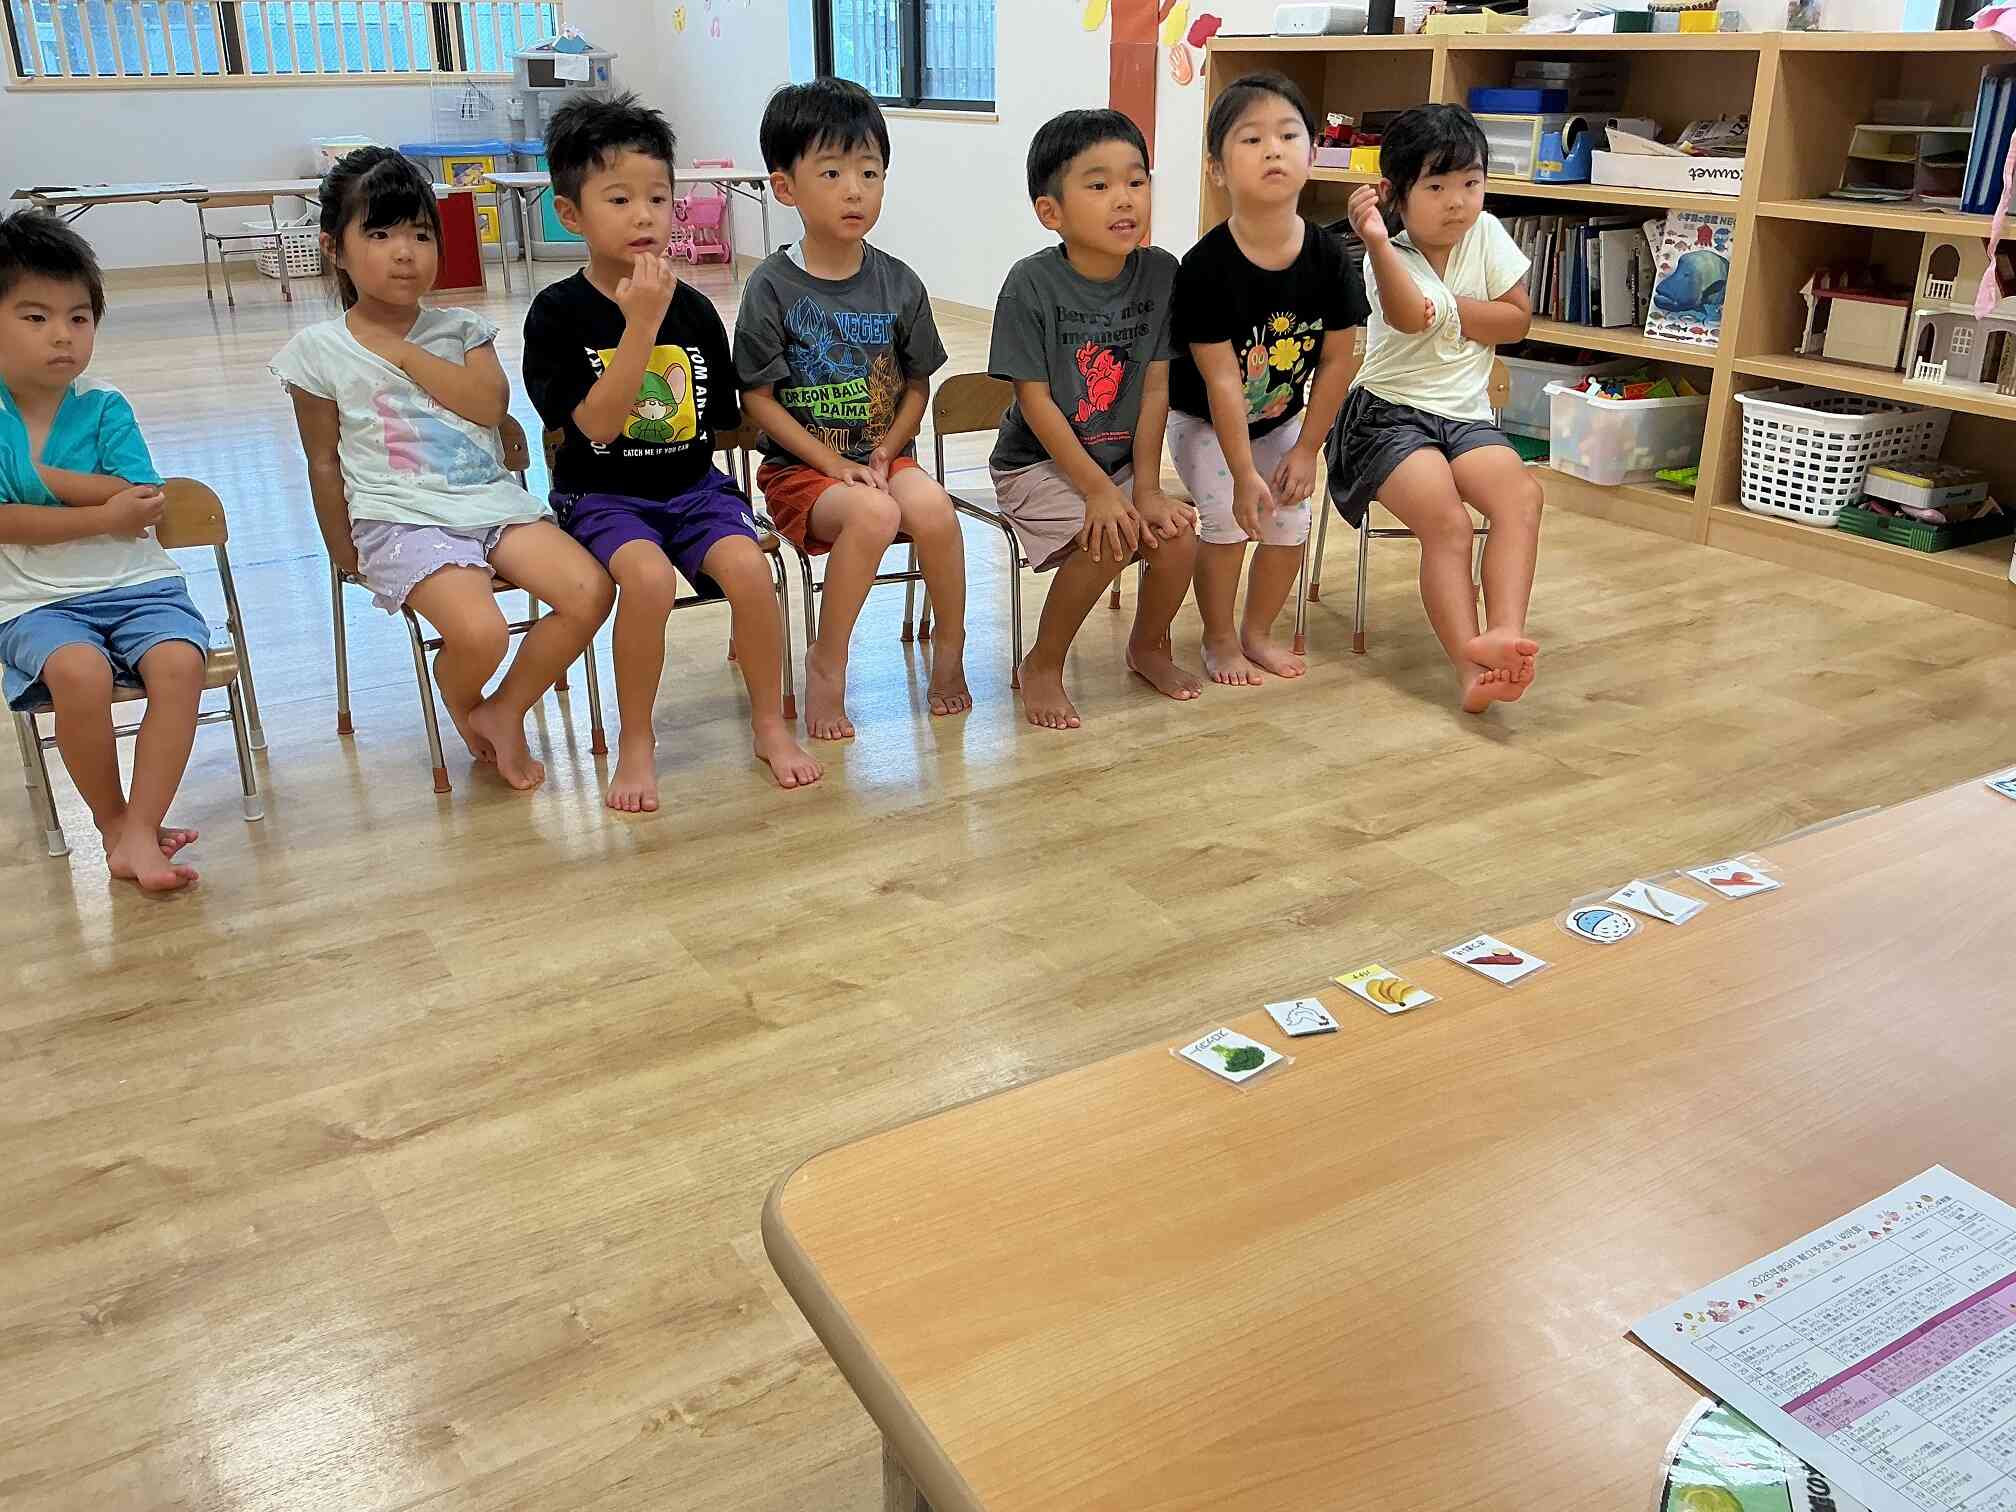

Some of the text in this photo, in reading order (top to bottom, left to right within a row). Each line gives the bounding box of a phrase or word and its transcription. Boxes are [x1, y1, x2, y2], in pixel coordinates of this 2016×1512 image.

[686, 346, 709, 380] TOM
[820, 402, 868, 417] DAIMA
[623, 449, 643, 457] CATCH
[644, 448, 655, 456] ME
